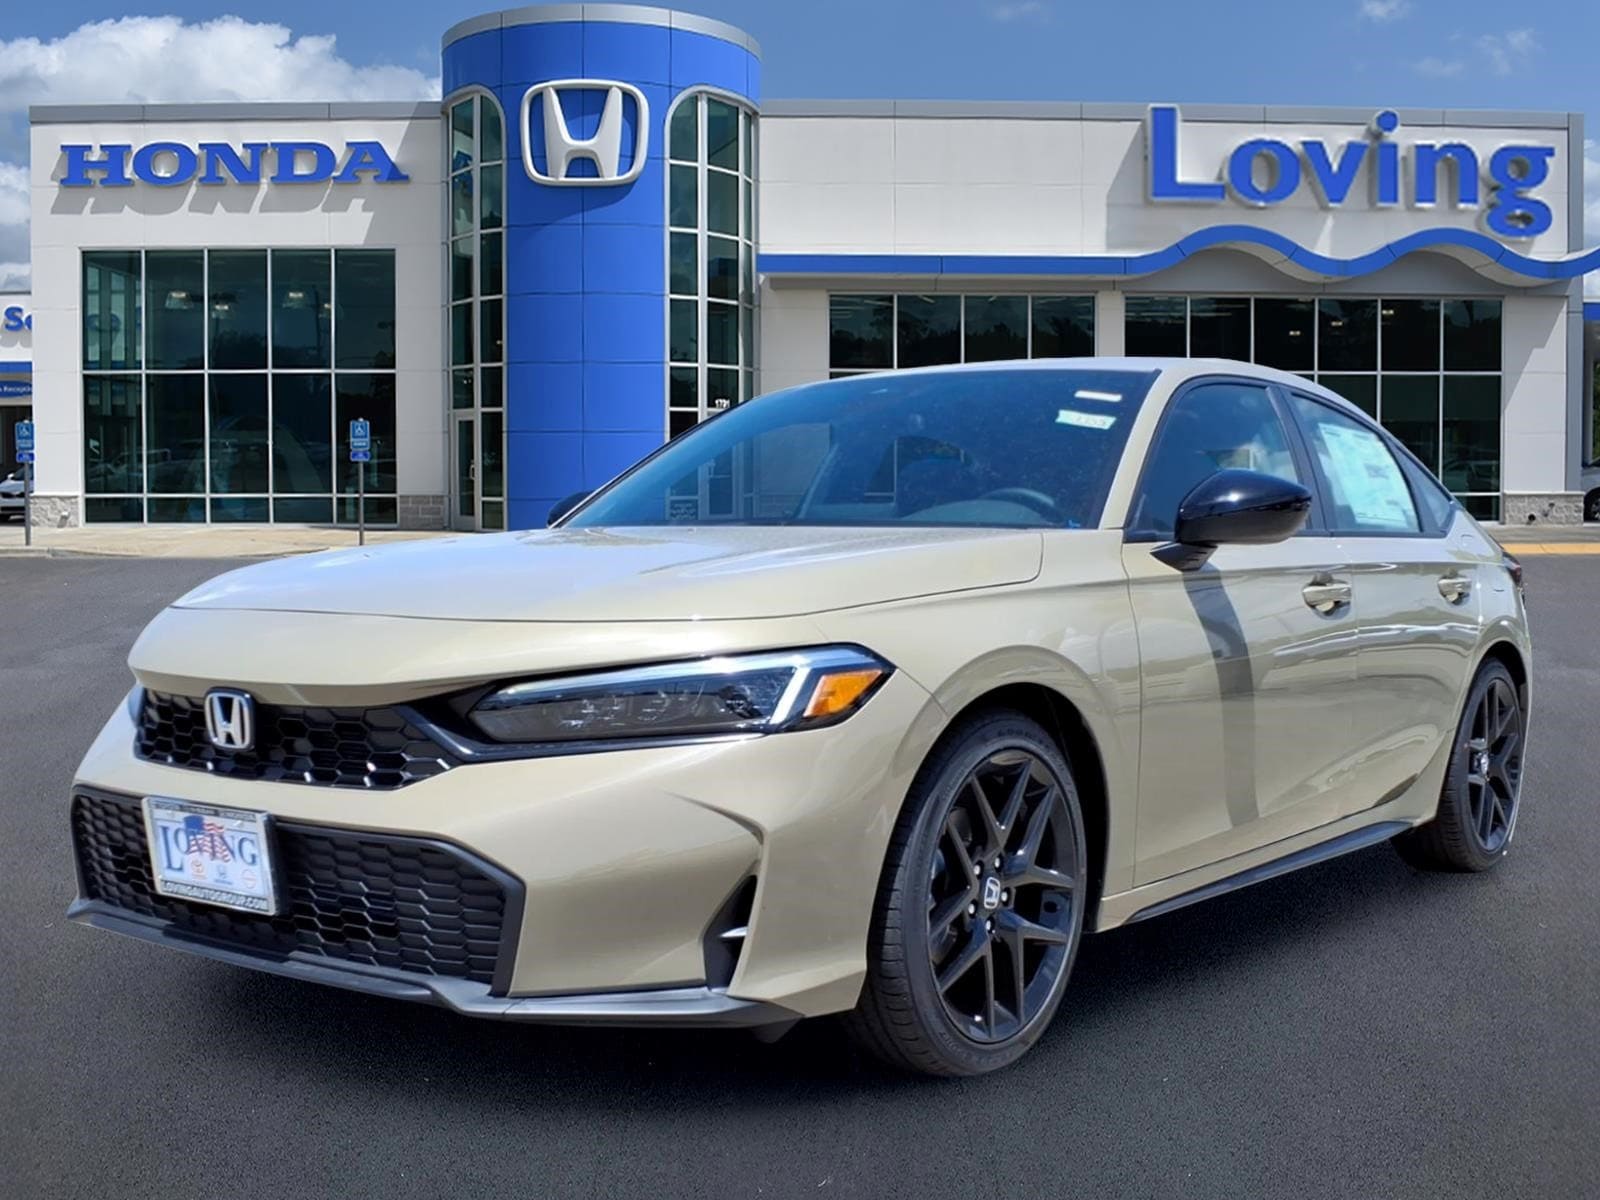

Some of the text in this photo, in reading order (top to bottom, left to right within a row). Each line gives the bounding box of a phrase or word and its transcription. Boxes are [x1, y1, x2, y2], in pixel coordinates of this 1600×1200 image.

[60, 140, 410, 186] HONDA
[1148, 104, 1556, 239] Loving
[160, 825, 258, 873] LOVING
